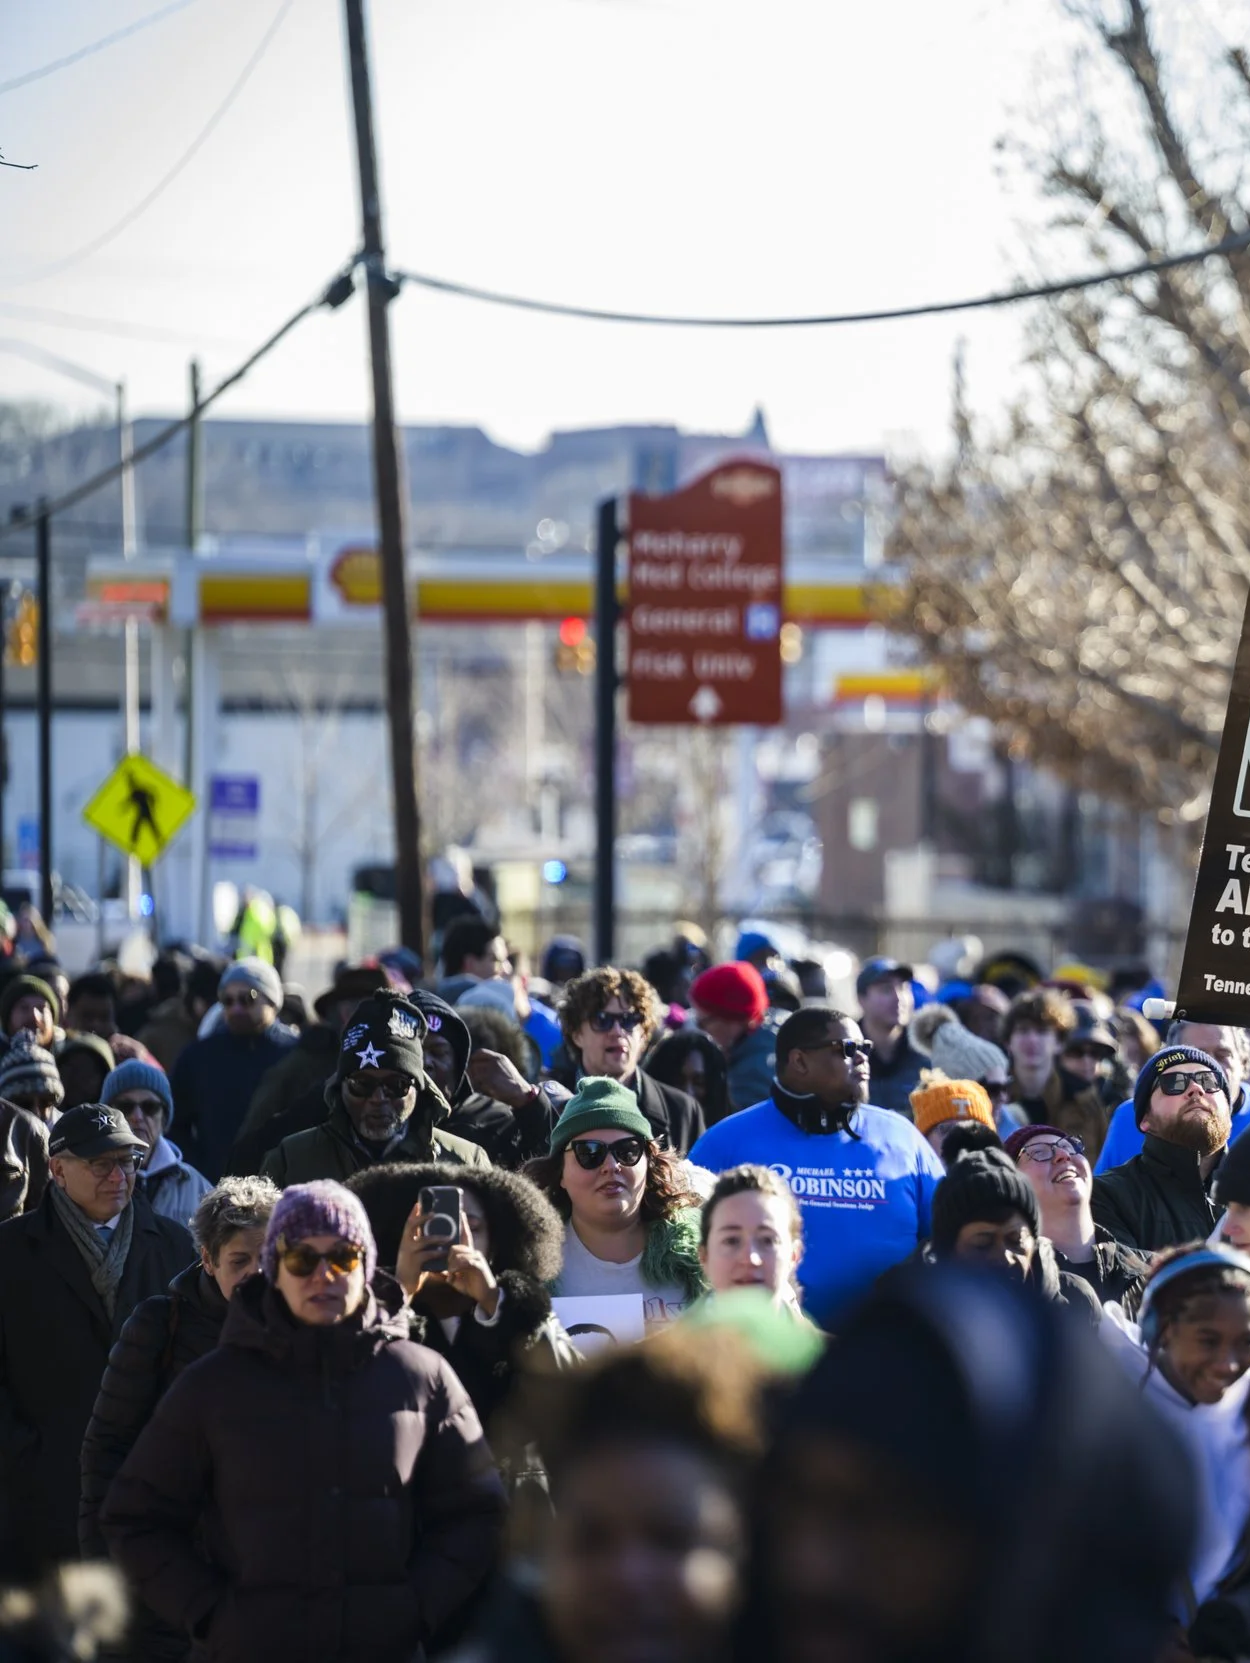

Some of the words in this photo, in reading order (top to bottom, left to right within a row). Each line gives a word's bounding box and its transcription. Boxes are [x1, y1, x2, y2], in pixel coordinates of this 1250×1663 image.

[687, 562, 777, 596] College
[632, 604, 739, 635] General
[1211, 923, 1235, 946] to
[1157, 1052, 1185, 1071] Irish
[952, 1098, 970, 1116] T
[796, 1167, 835, 1177] MICHAEL
